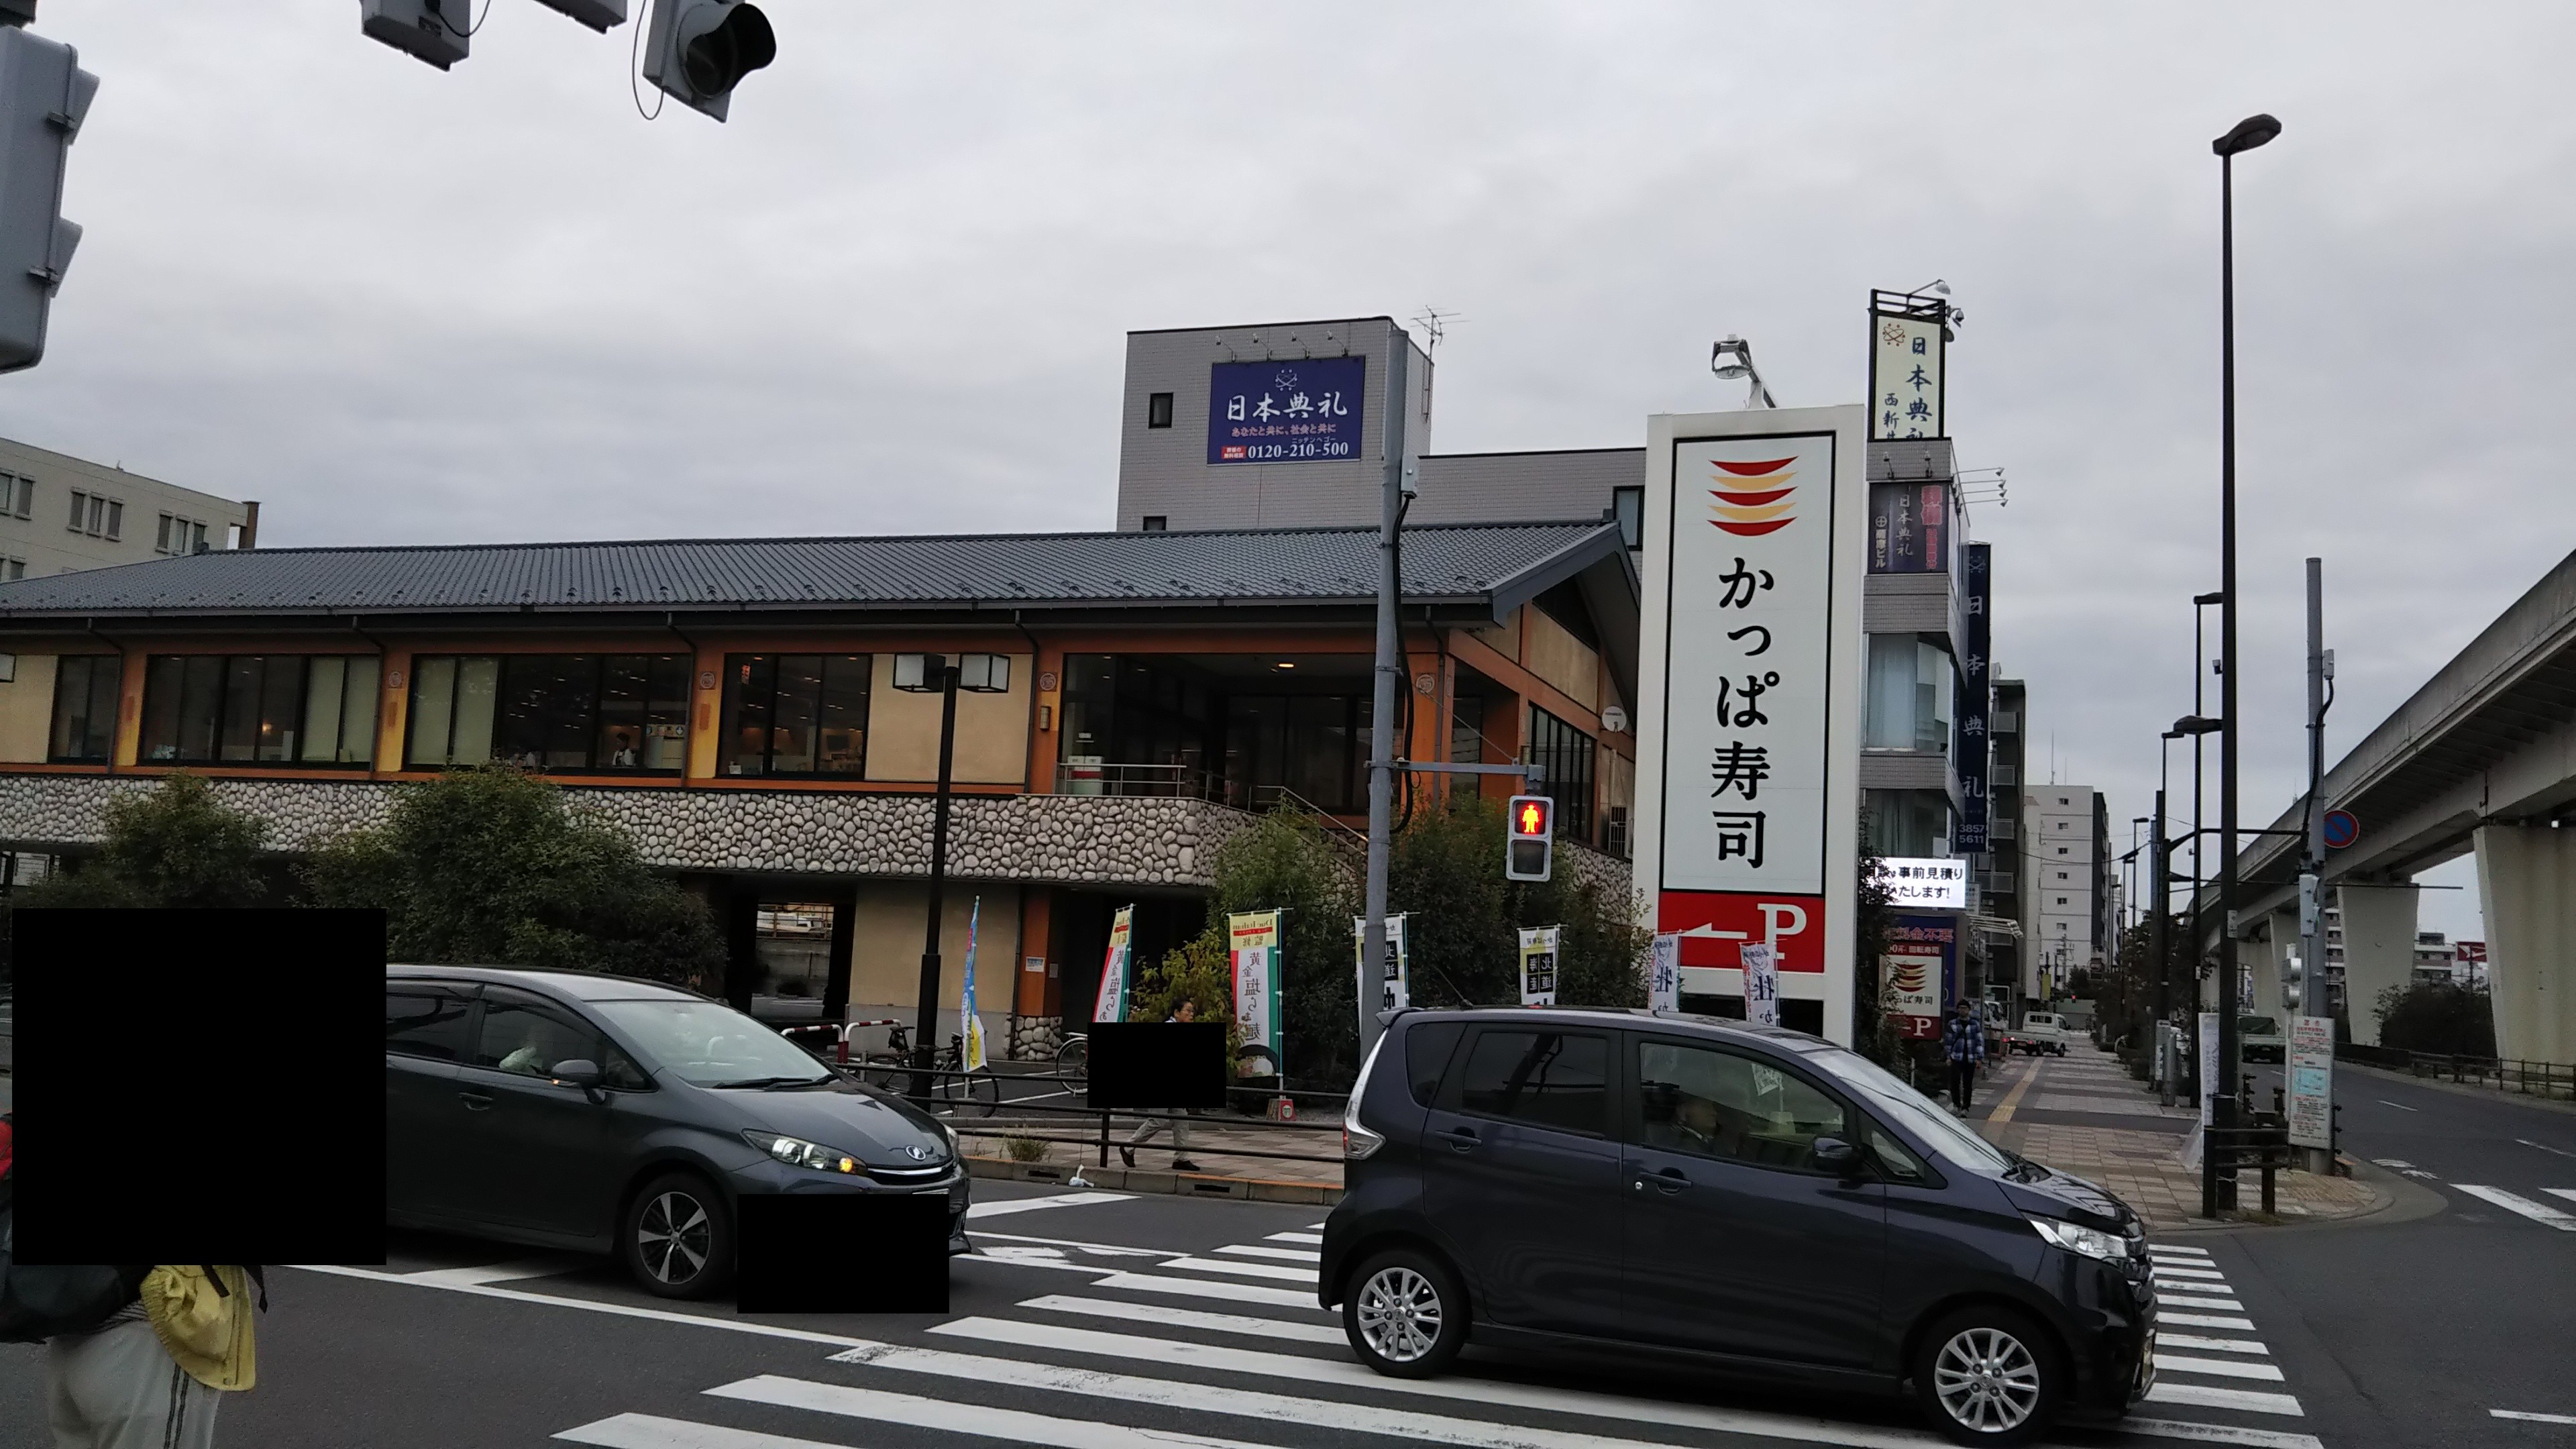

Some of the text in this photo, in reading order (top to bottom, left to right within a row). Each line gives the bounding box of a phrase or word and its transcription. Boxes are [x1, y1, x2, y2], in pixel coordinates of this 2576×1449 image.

[1227, 390, 1348, 423] 日本典礼
[1248, 442, 1349, 459] 0120-210-500
[1896, 494, 1913, 557] 日本典礼
[1962, 595, 1986, 798] 日本典礼
[1711, 556, 1780, 870] かっぱ寿司
[1959, 824, 1985, 833] 3857
[1959, 835, 1984, 844] 5611
[1898, 885, 1950, 899] たします!
[1757, 902, 1807, 960] P
[1913, 1017, 1932, 1036] P
